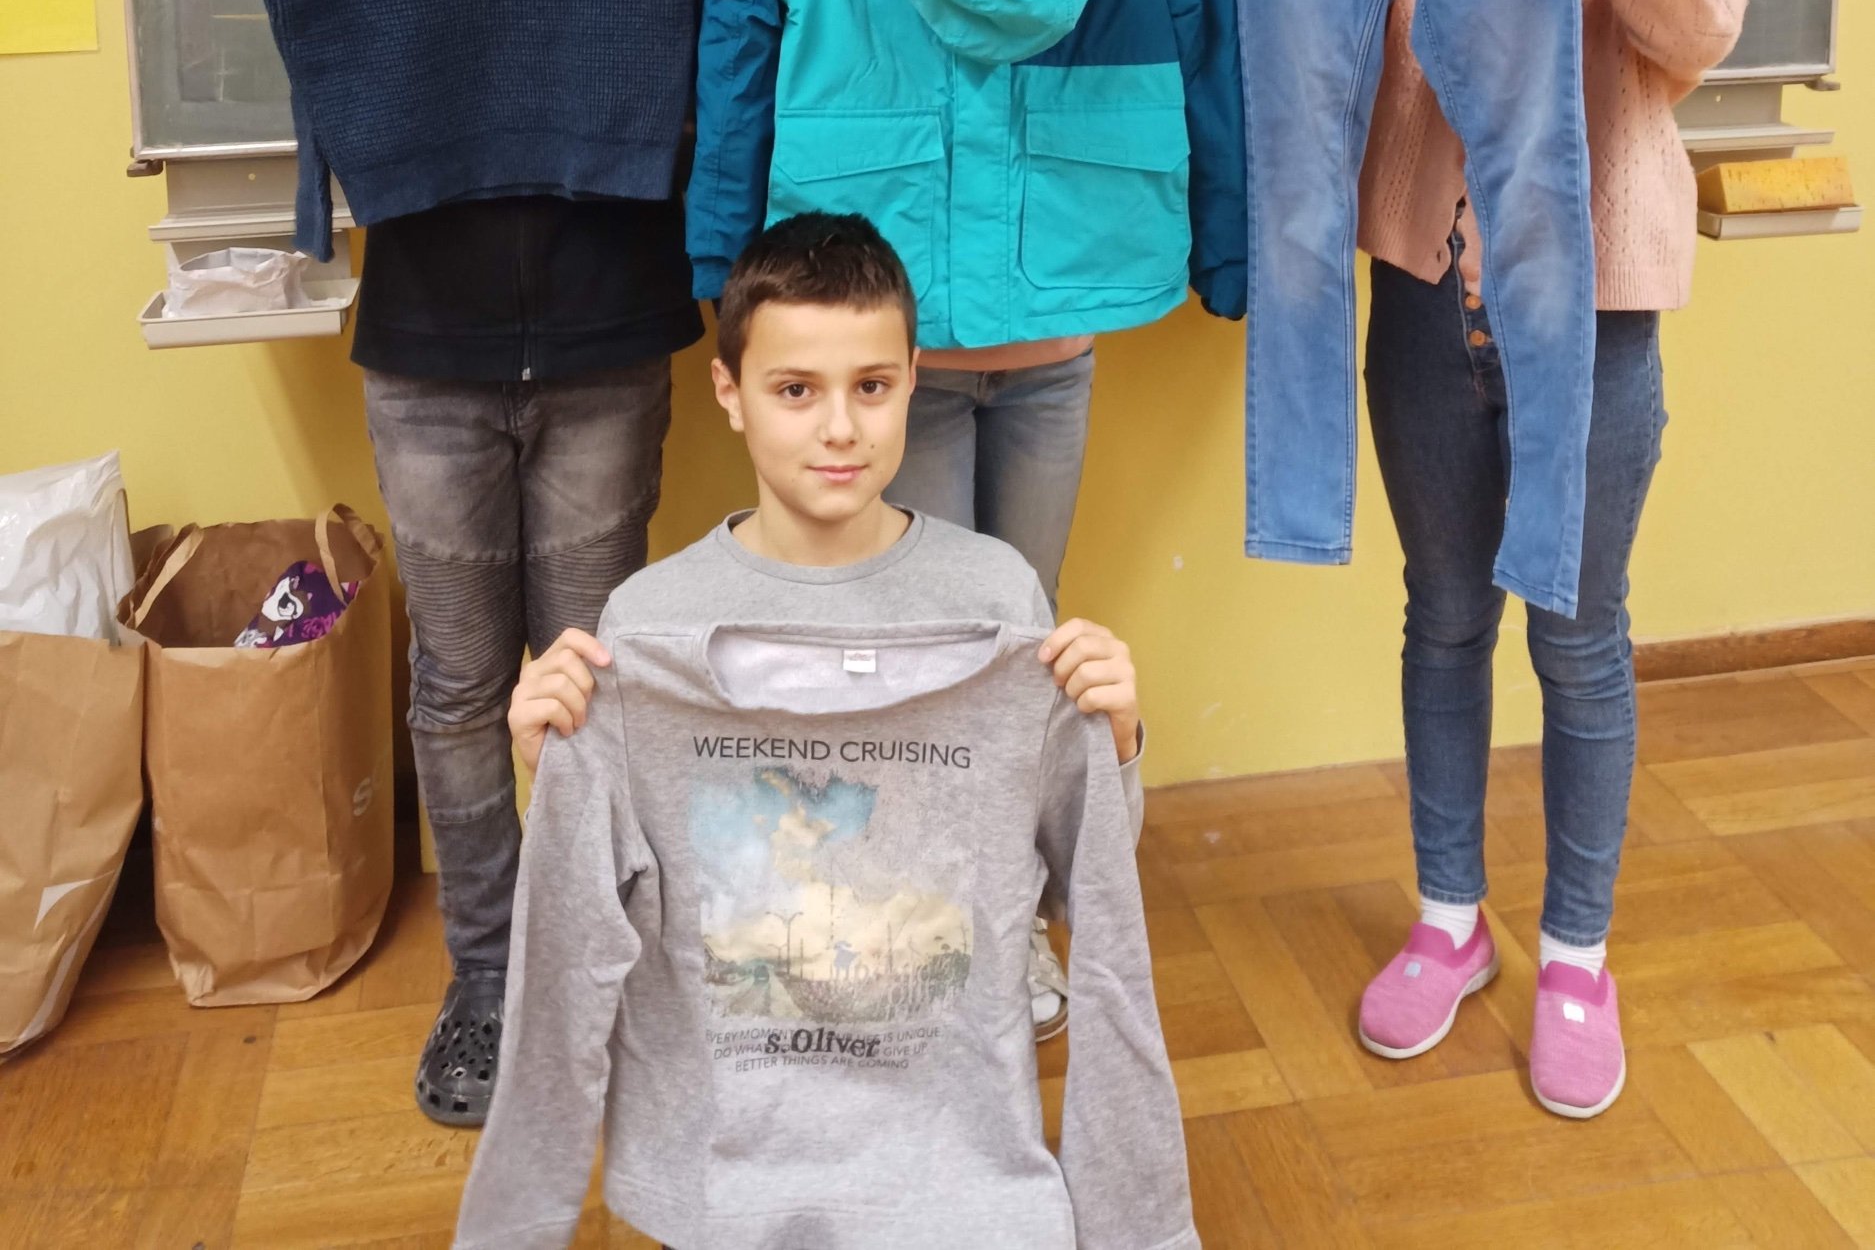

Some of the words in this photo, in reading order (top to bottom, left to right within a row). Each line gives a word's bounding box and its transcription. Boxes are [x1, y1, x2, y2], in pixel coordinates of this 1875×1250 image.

[693, 736, 831, 761] WEEKEND
[839, 741, 971, 769] CRUISING
[714, 1047, 732, 1060] DO
[883, 1044, 910, 1057] GIVE
[913, 1042, 928, 1055] UP
[764, 1027, 881, 1058] s.Oliver
[735, 1054, 778, 1073] BETTER
[782, 1053, 828, 1065] THINGS
[831, 1055, 854, 1067] ARE
[857, 1060, 910, 1070] COMING
